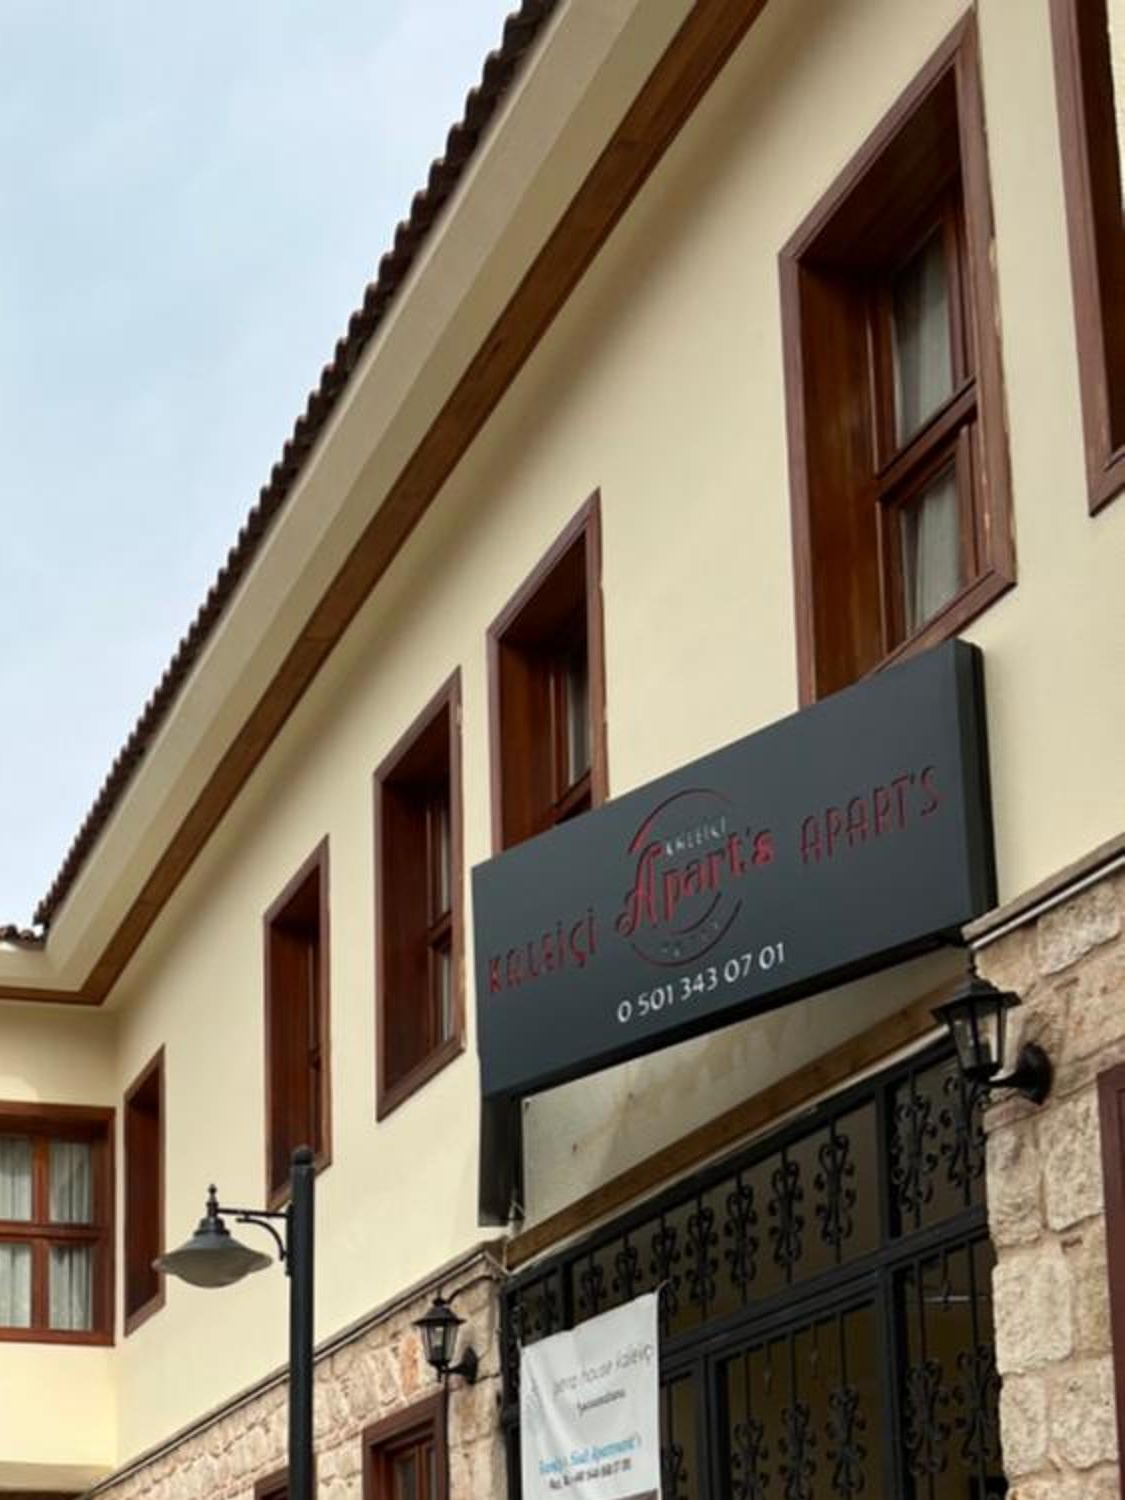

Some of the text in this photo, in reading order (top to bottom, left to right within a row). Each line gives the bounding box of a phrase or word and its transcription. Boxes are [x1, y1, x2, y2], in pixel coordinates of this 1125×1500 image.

[800, 766, 942, 863] APART'S
[615, 827, 775, 937] Apart's
[616, 941, 786, 1024] 0 501 343 07 01
